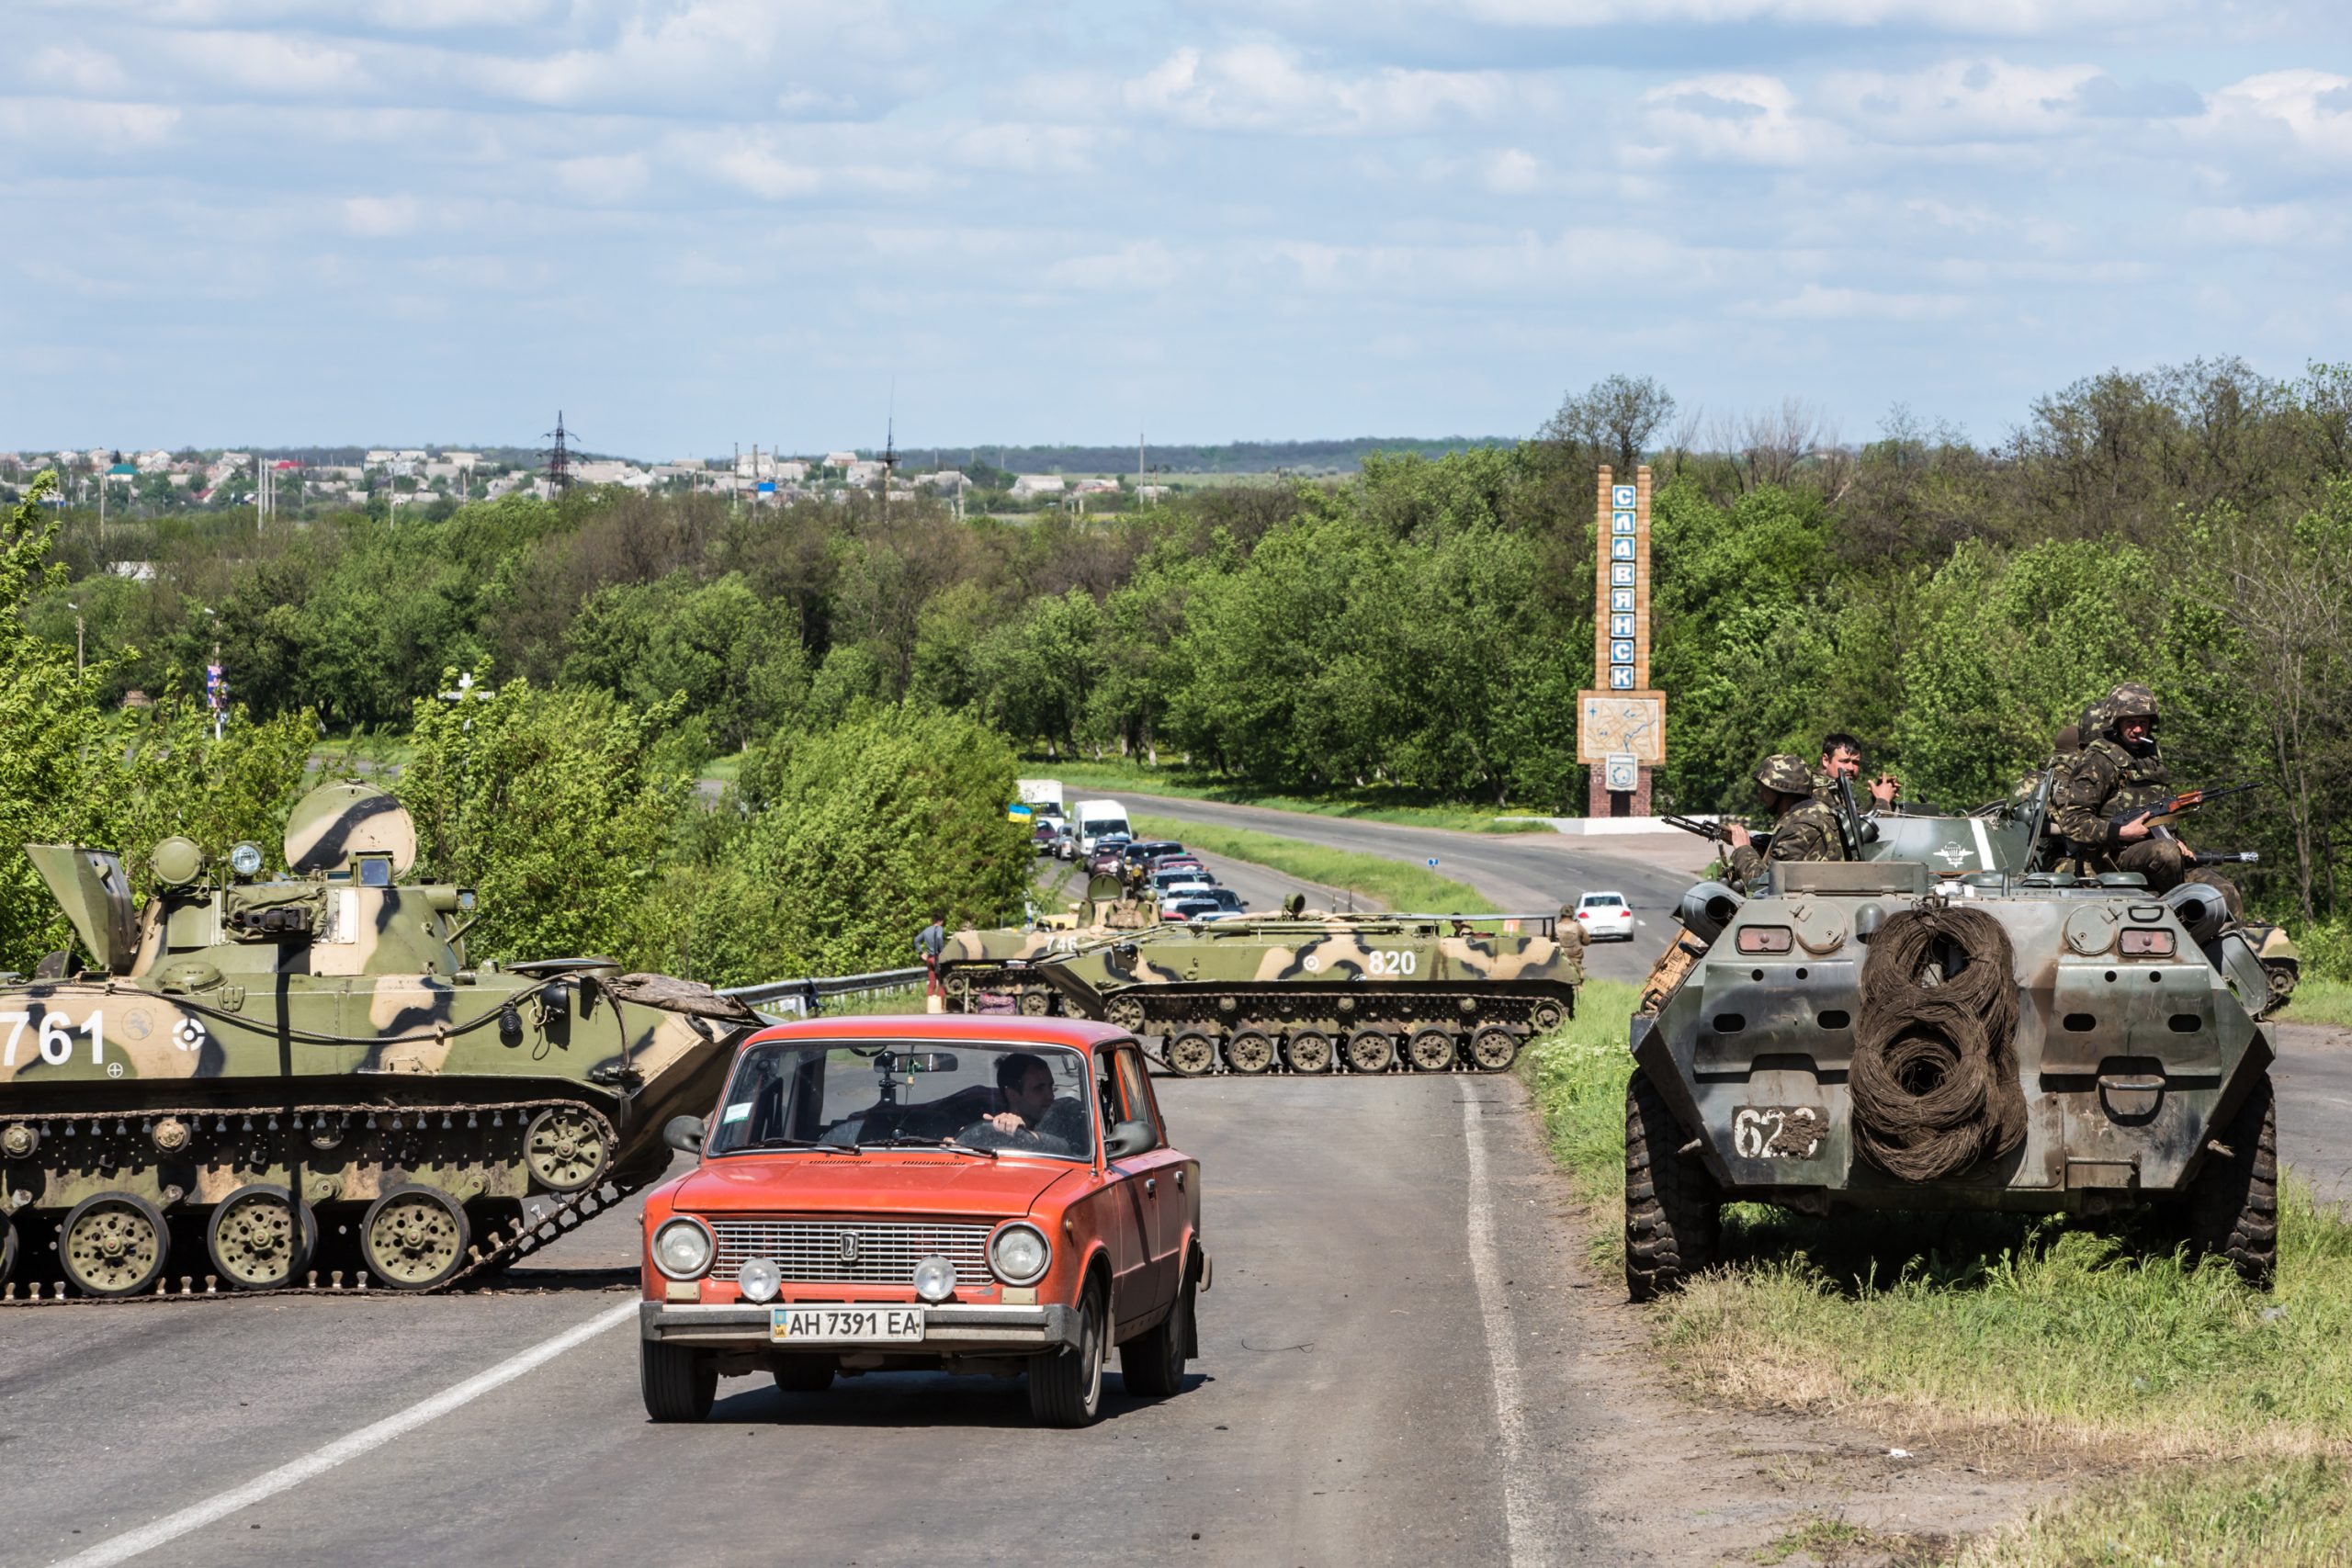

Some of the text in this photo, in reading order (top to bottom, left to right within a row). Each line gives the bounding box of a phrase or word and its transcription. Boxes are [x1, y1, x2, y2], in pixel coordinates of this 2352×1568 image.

[1613, 489, 1633, 685] СЛАВЯНСК
[1044, 936, 1079, 953] 746
[1368, 950, 1417, 976] 820
[0, 1010, 104, 1066] 761
[789, 1312, 918, 1336] AH 7391 EA
